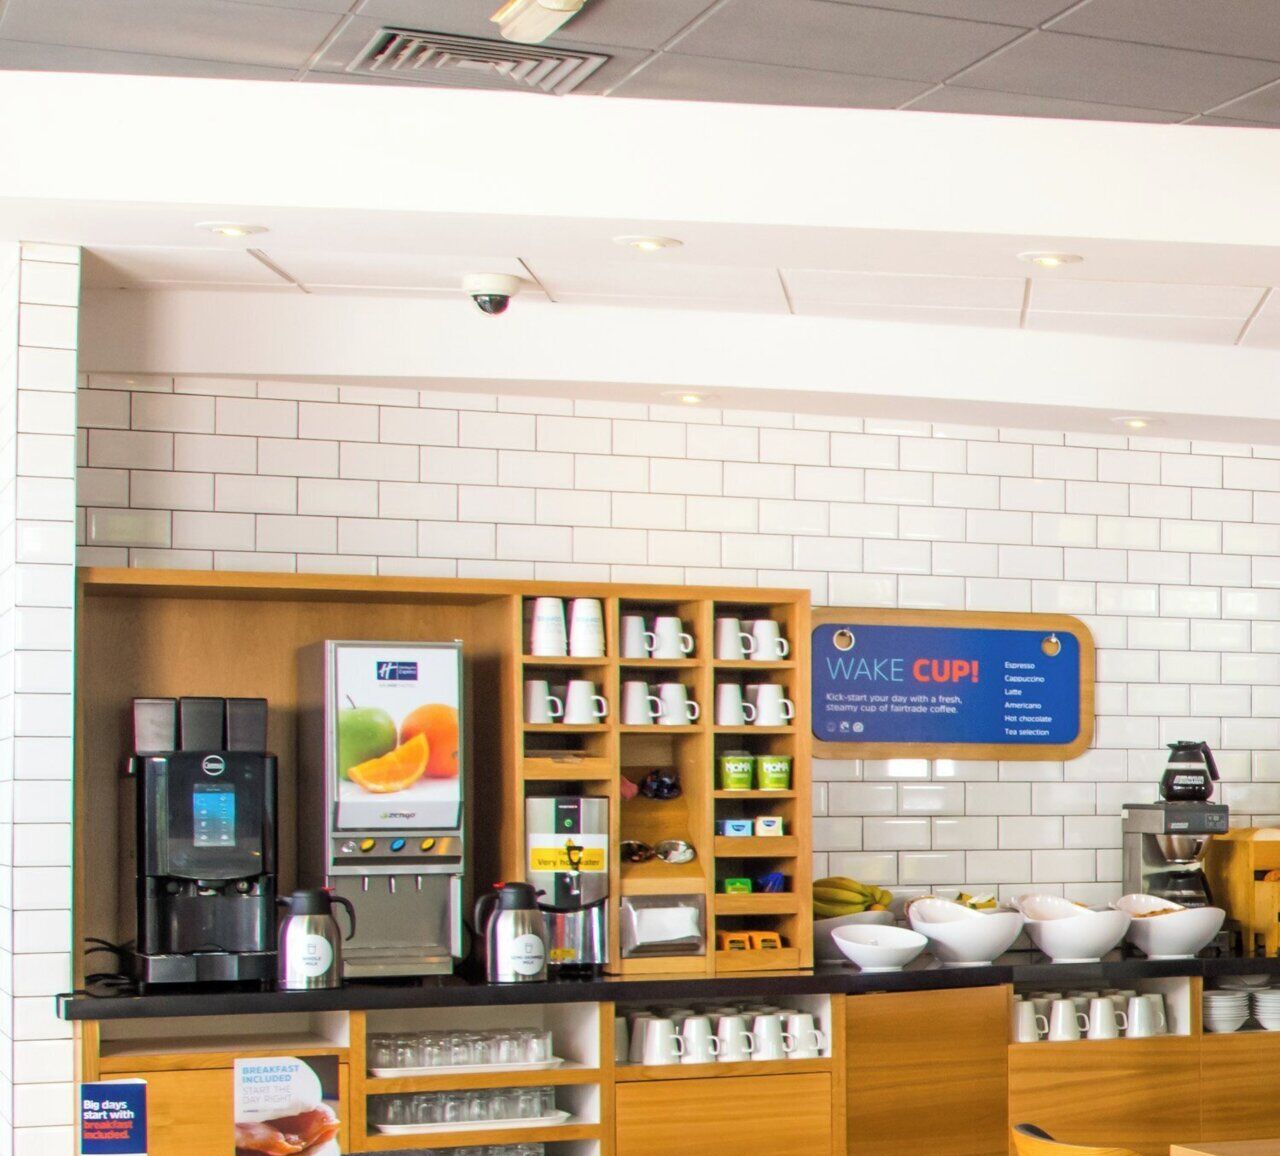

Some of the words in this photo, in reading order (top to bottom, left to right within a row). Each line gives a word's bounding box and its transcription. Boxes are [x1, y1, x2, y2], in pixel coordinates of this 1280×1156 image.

[826, 656, 904, 683] WAKE
[912, 658, 979, 684] CUP!
[1004, 661, 1036, 671] Espresso
[1004, 674, 1046, 684] Cappuccino
[1004, 688, 1022, 696] Latte
[826, 692, 868, 702] Kick-start
[869, 694, 889, 704] your
[891, 694, 908, 704] day
[909, 694, 929, 703] with
[938, 695, 963, 704] fresh,
[826, 704, 858, 713] steamy
[860, 705, 877, 713] cup
[878, 704, 888, 713] of
[890, 704, 928, 714] fairtrade
[929, 704, 959, 714] coffee.
[1004, 702, 1042, 710] Americano
[1004, 715, 1018, 723] Hot
[1018, 715, 1053, 723] chocolate
[1004, 728, 1016, 736] Tea
[1015, 728, 1050, 737] selection
[242, 1064, 300, 1075] BREAKFAST
[241, 1073, 292, 1084] INCLUDED
[83, 1099, 100, 1112] Big
[101, 1099, 128, 1112] days
[83, 1110, 108, 1120] start
[108, 1109, 135, 1120] with
[83, 1119, 133, 1130] breakfast
[83, 1129, 130, 1140] included.
